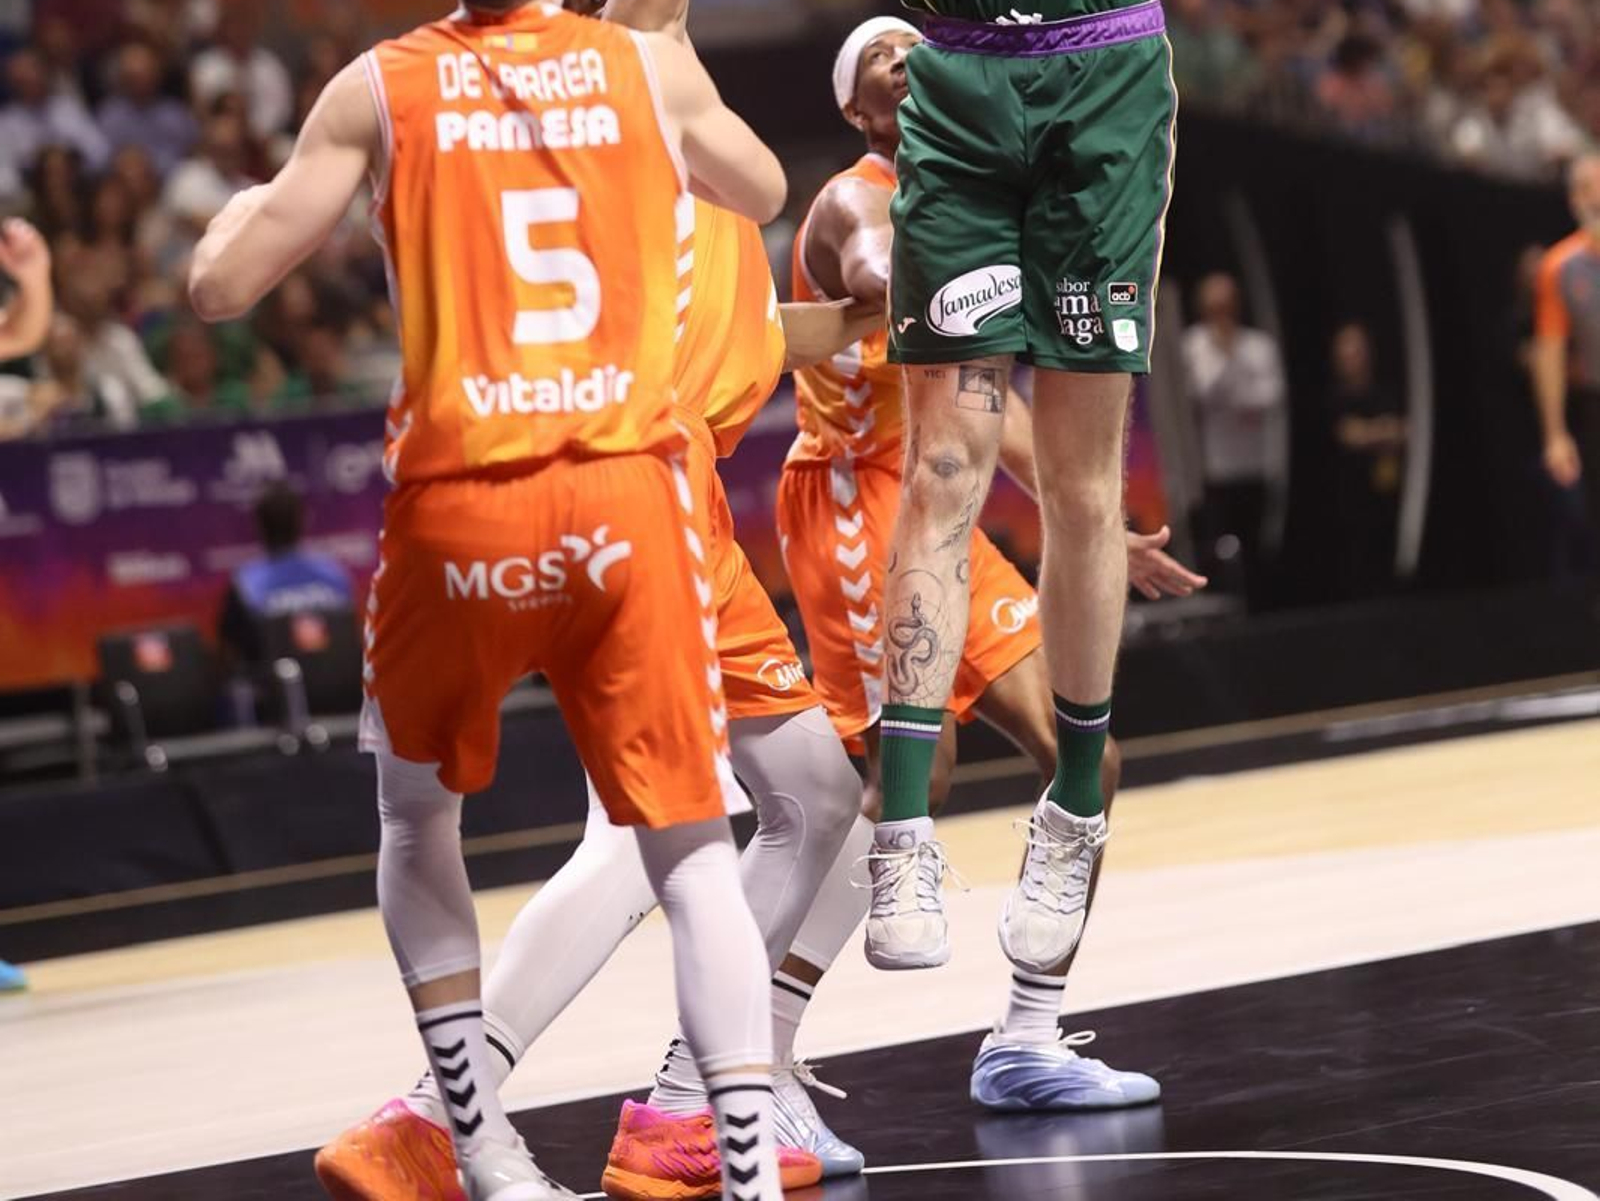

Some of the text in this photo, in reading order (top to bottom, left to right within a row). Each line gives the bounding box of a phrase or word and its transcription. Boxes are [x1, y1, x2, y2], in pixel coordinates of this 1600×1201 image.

[435, 51, 482, 101] DE
[434, 104, 621, 153] PAMESA
[501, 187, 601, 345] 5
[443, 550, 567, 600] MGS
